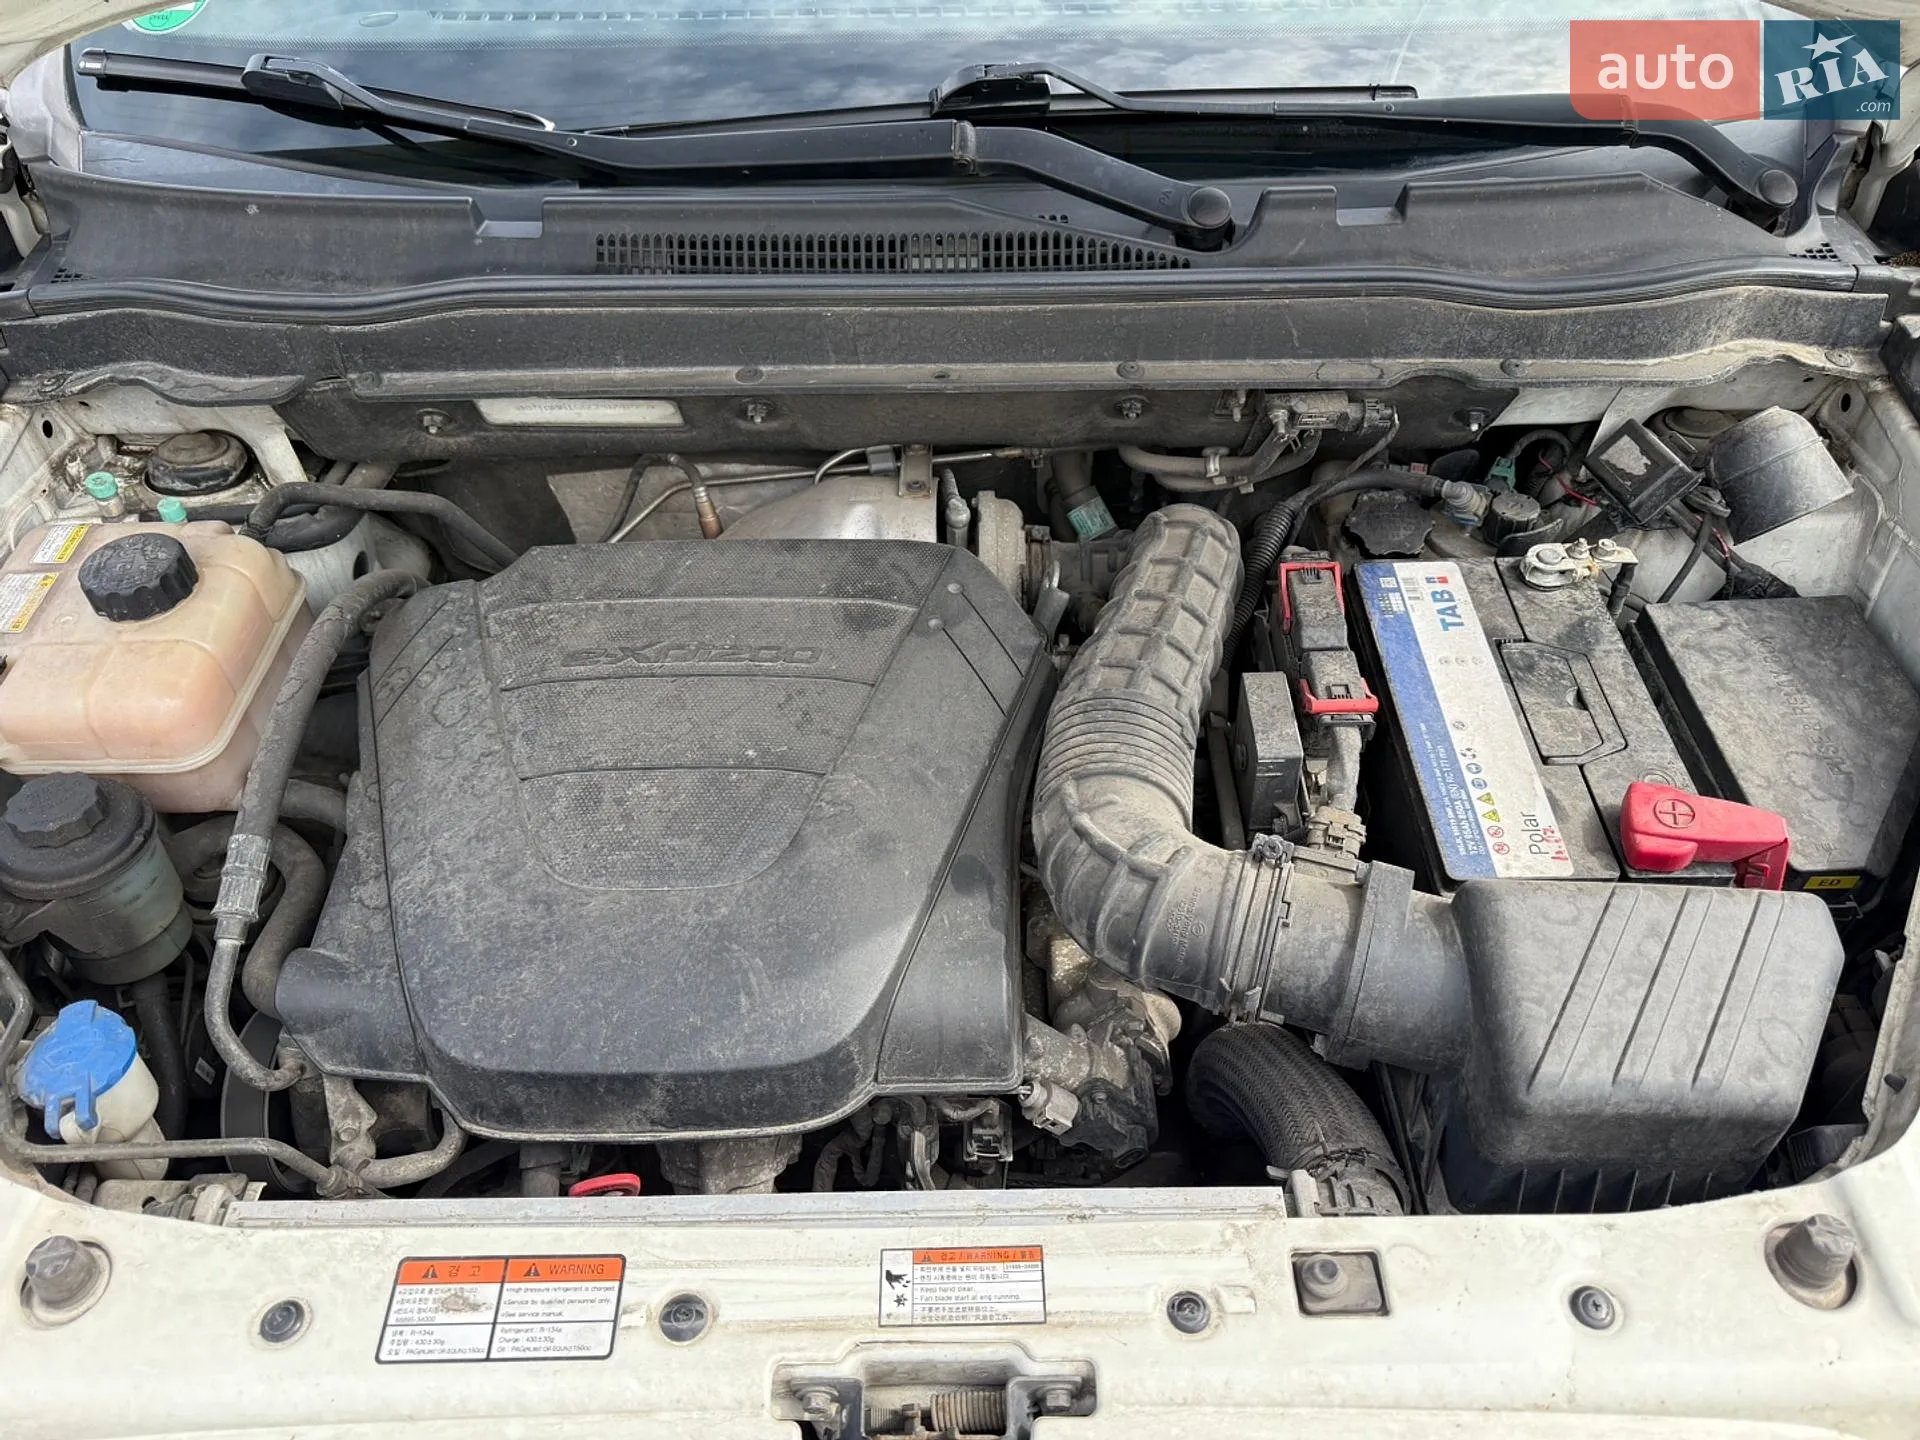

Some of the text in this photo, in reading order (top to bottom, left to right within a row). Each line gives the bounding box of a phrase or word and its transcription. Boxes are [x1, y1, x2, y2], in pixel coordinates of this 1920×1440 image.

[1431, 589, 1464, 632] TAB
[1756, 636, 1782, 664] BOX
[1521, 812, 1549, 854] Polar
[1818, 878, 1841, 887] ED
[966, 1251, 1010, 1260] WARNING
[549, 1264, 604, 1275] WARNING
